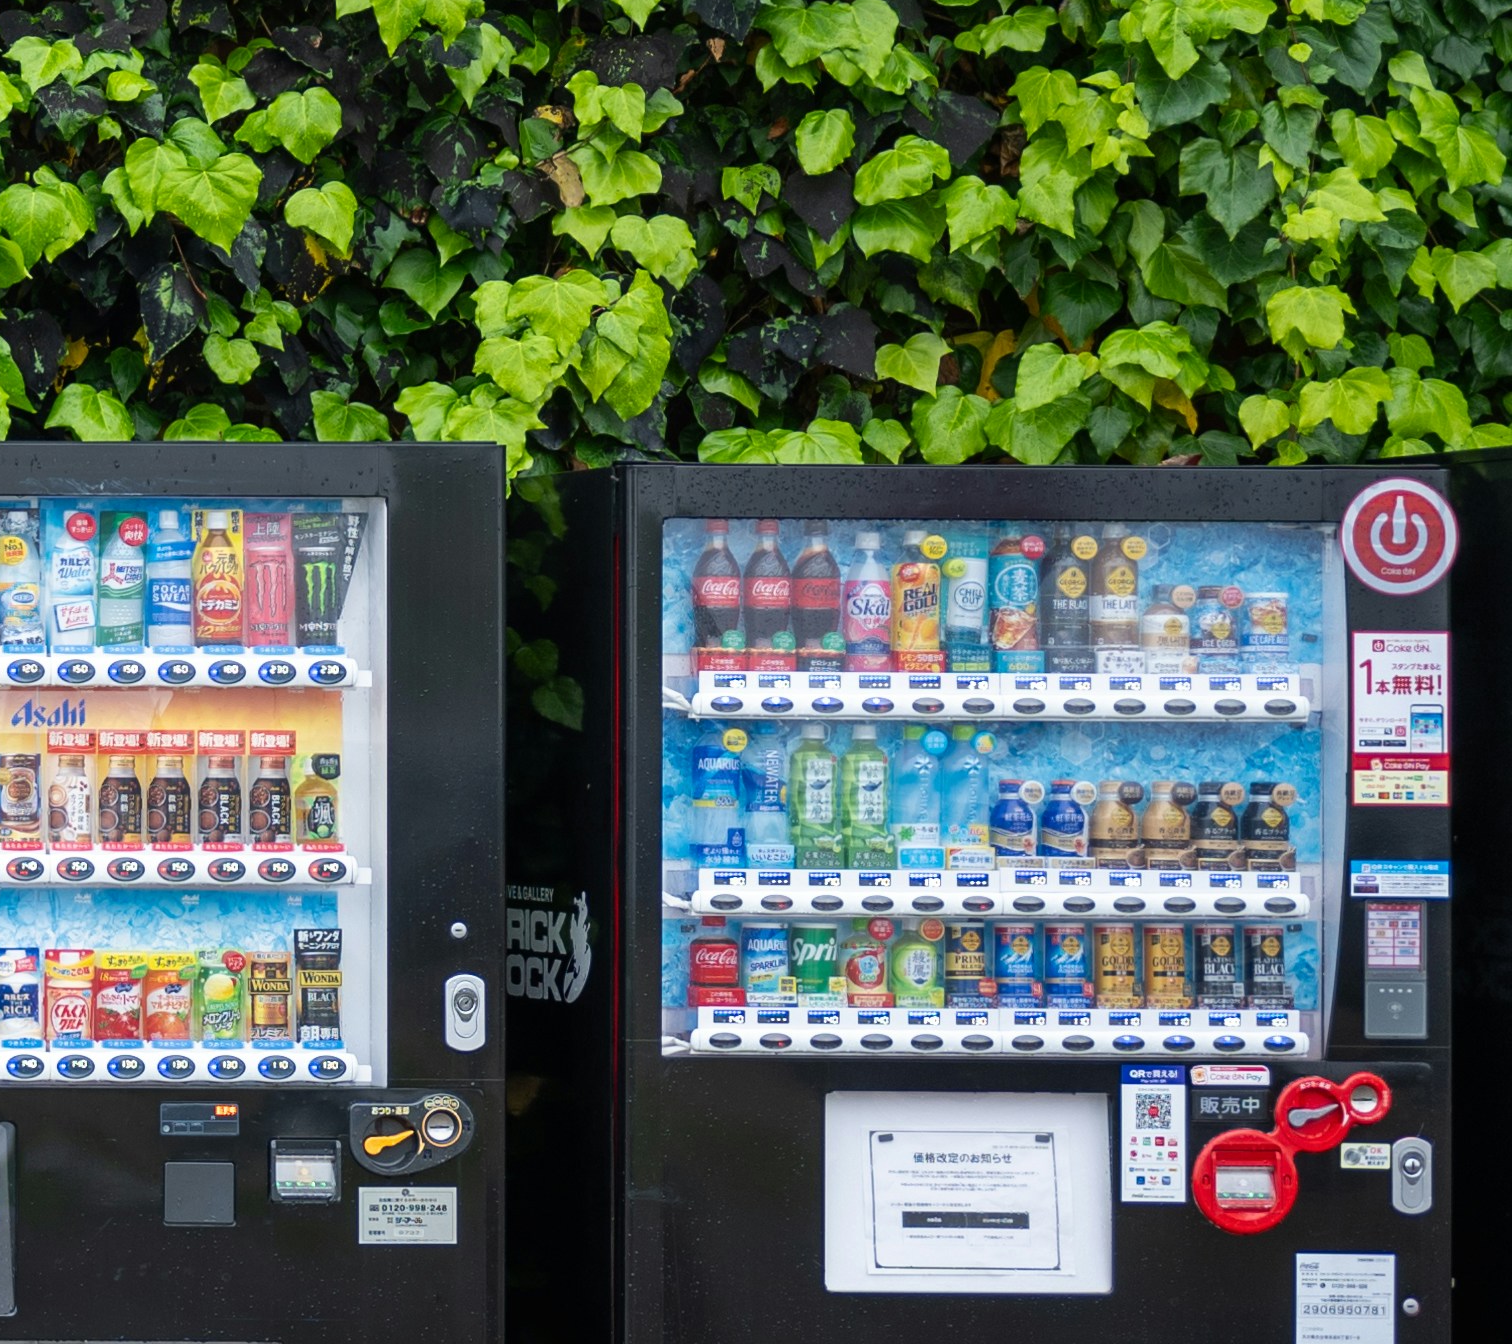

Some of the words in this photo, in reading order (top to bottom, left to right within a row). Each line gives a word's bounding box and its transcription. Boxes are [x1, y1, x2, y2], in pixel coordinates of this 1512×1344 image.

[252, 521, 281, 536] 上陸
[59, 557, 90, 566] カルピス
[57, 568, 90, 579] Water
[1381, 567, 1401, 575] Coke
[1014, 568, 1028, 602] 麦茶
[904, 583, 937, 601] REAL
[958, 588, 983, 598] CHILL
[904, 597, 938, 613] GOLD
[962, 597, 980, 605] OUT
[1053, 600, 1067, 610] THE
[1102, 600, 1118, 610] THE
[1386, 644, 1411, 652] Coke
[1391, 663, 1441, 671] スタンプたまると
[11, 699, 85, 727] Asahi
[1384, 762, 1402, 770] Coke
[1416, 762, 1430, 771] Pay
[765, 750, 779, 803] NEWATER
[220, 794, 229, 825] BLACK
[271, 794, 281, 825] BLACK
[507, 908, 567, 955] RICK
[303, 972, 339, 983] WONDA
[506, 954, 562, 1002] OCK
[251, 980, 289, 992] WONDA
[3, 1006, 31, 1014] RICH
[1210, 1072, 1229, 1081] Coke
[1246, 1073, 1262, 1082] Pay
[1200, 1096, 1260, 1114] 販売中
[913, 1152, 1012, 1164] 価格改定のお知らせ
[1303, 1305, 1385, 1315] 2906950781
